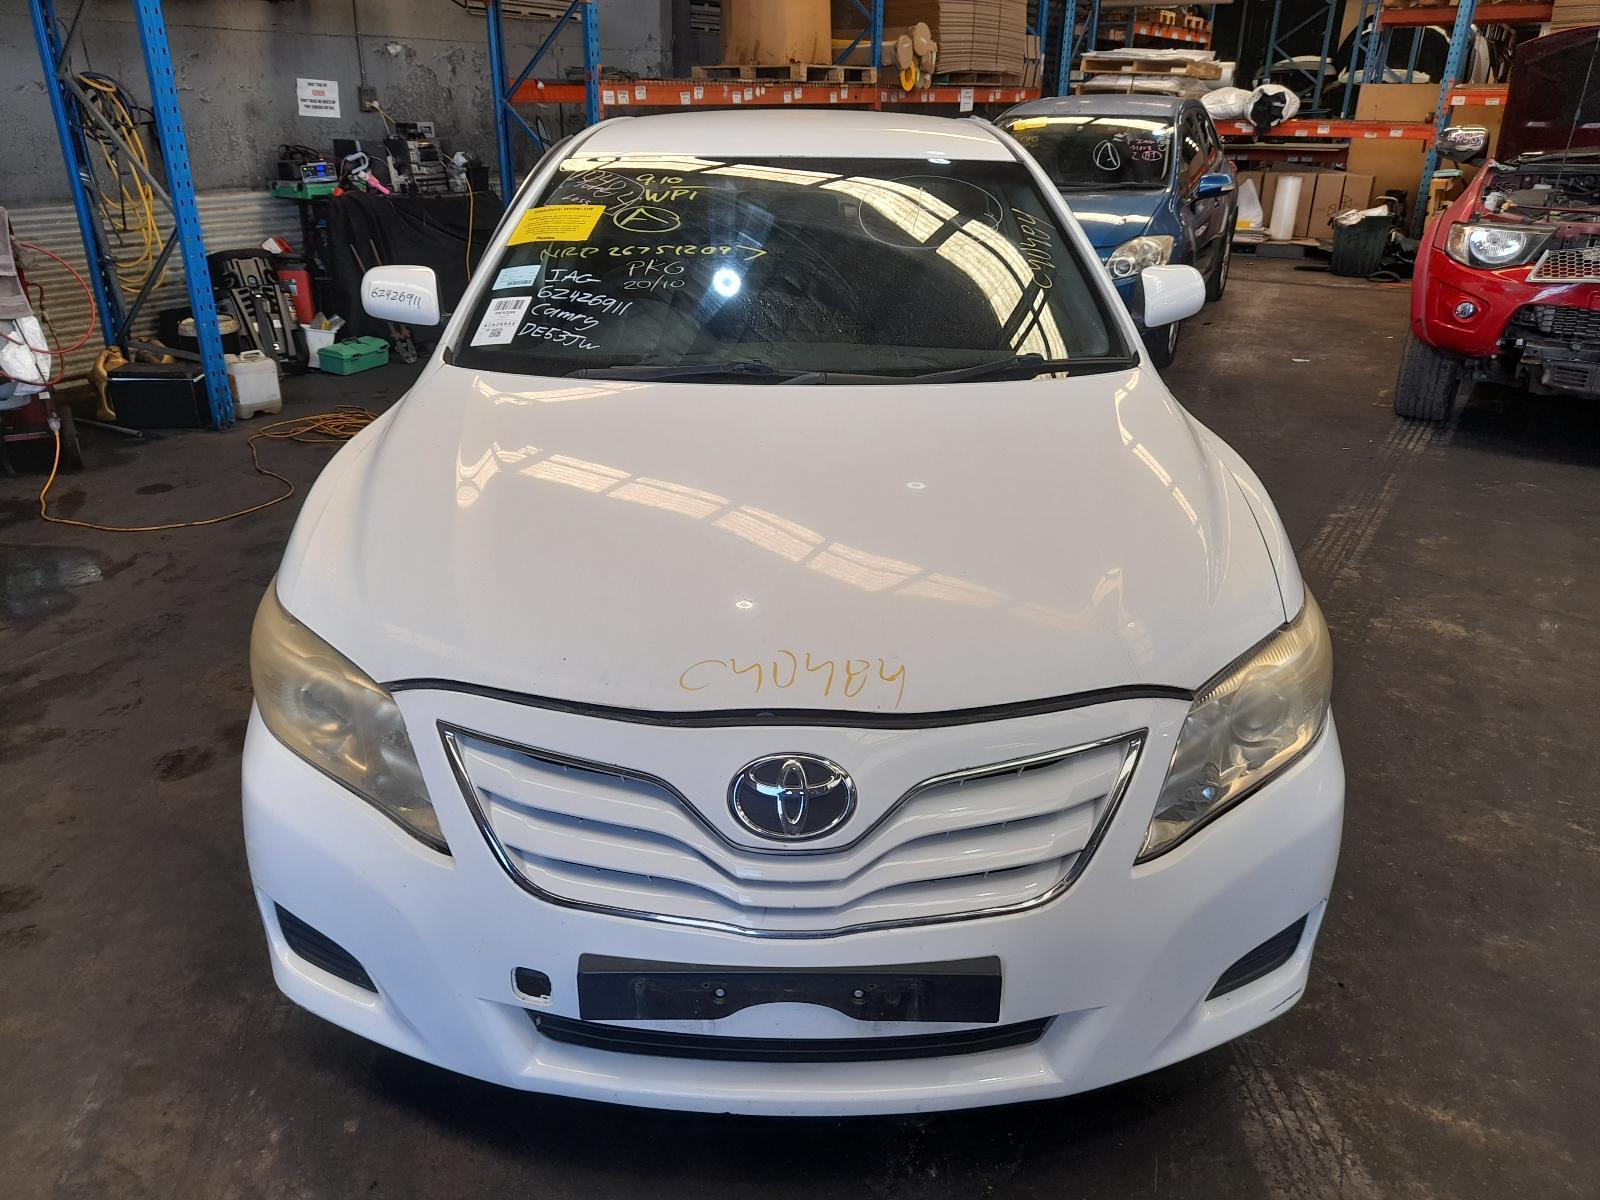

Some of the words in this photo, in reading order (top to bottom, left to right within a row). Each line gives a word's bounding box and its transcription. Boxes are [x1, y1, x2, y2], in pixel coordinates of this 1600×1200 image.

[544, 268, 601, 284] IAG
[625, 258, 686, 277] PKG
[623, 272, 686, 292] 20/10
[371, 287, 422, 310] 62426911
[536, 285, 633, 316] 62426911
[531, 303, 600, 331] Camry
